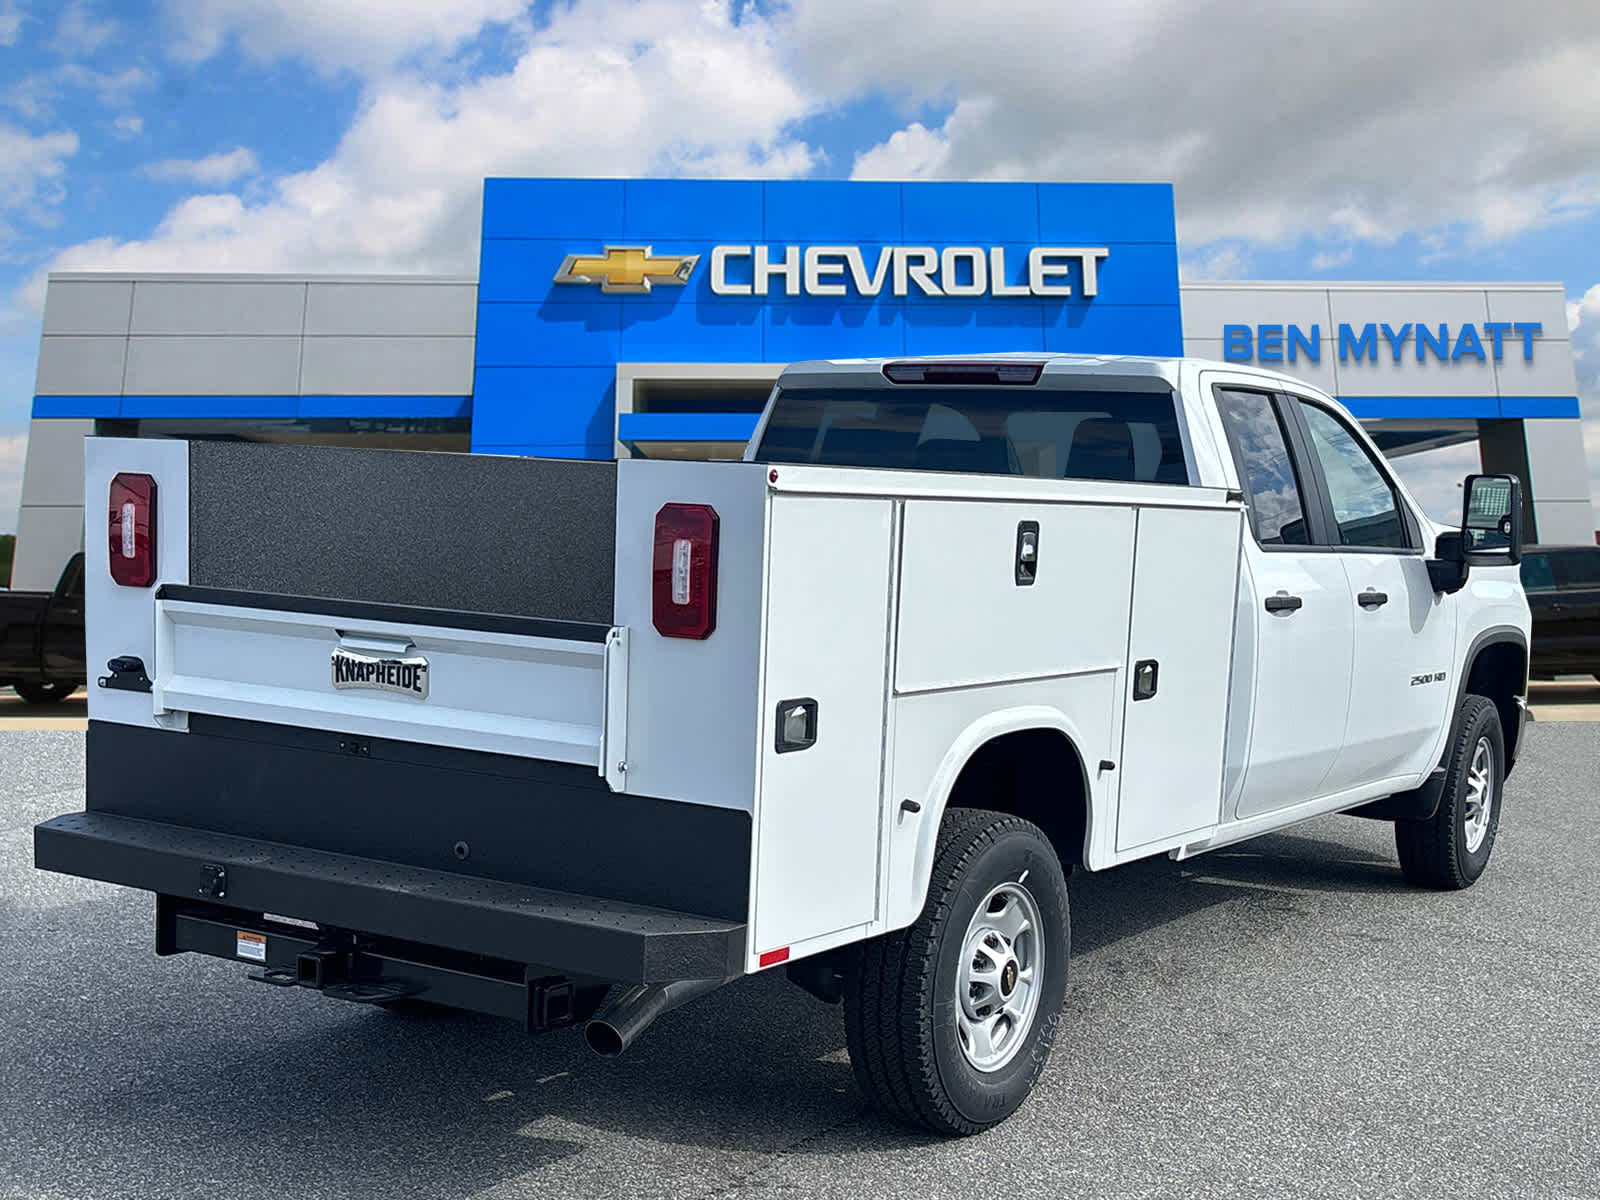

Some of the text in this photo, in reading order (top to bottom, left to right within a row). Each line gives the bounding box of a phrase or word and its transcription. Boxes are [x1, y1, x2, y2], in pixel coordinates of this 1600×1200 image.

[711, 245, 1109, 296] CHEVROLET
[1223, 322, 1543, 361] BEN MYNATT
[335, 655, 422, 693] KNAPHEIDE
[1410, 672, 1446, 686] 2500 HD
